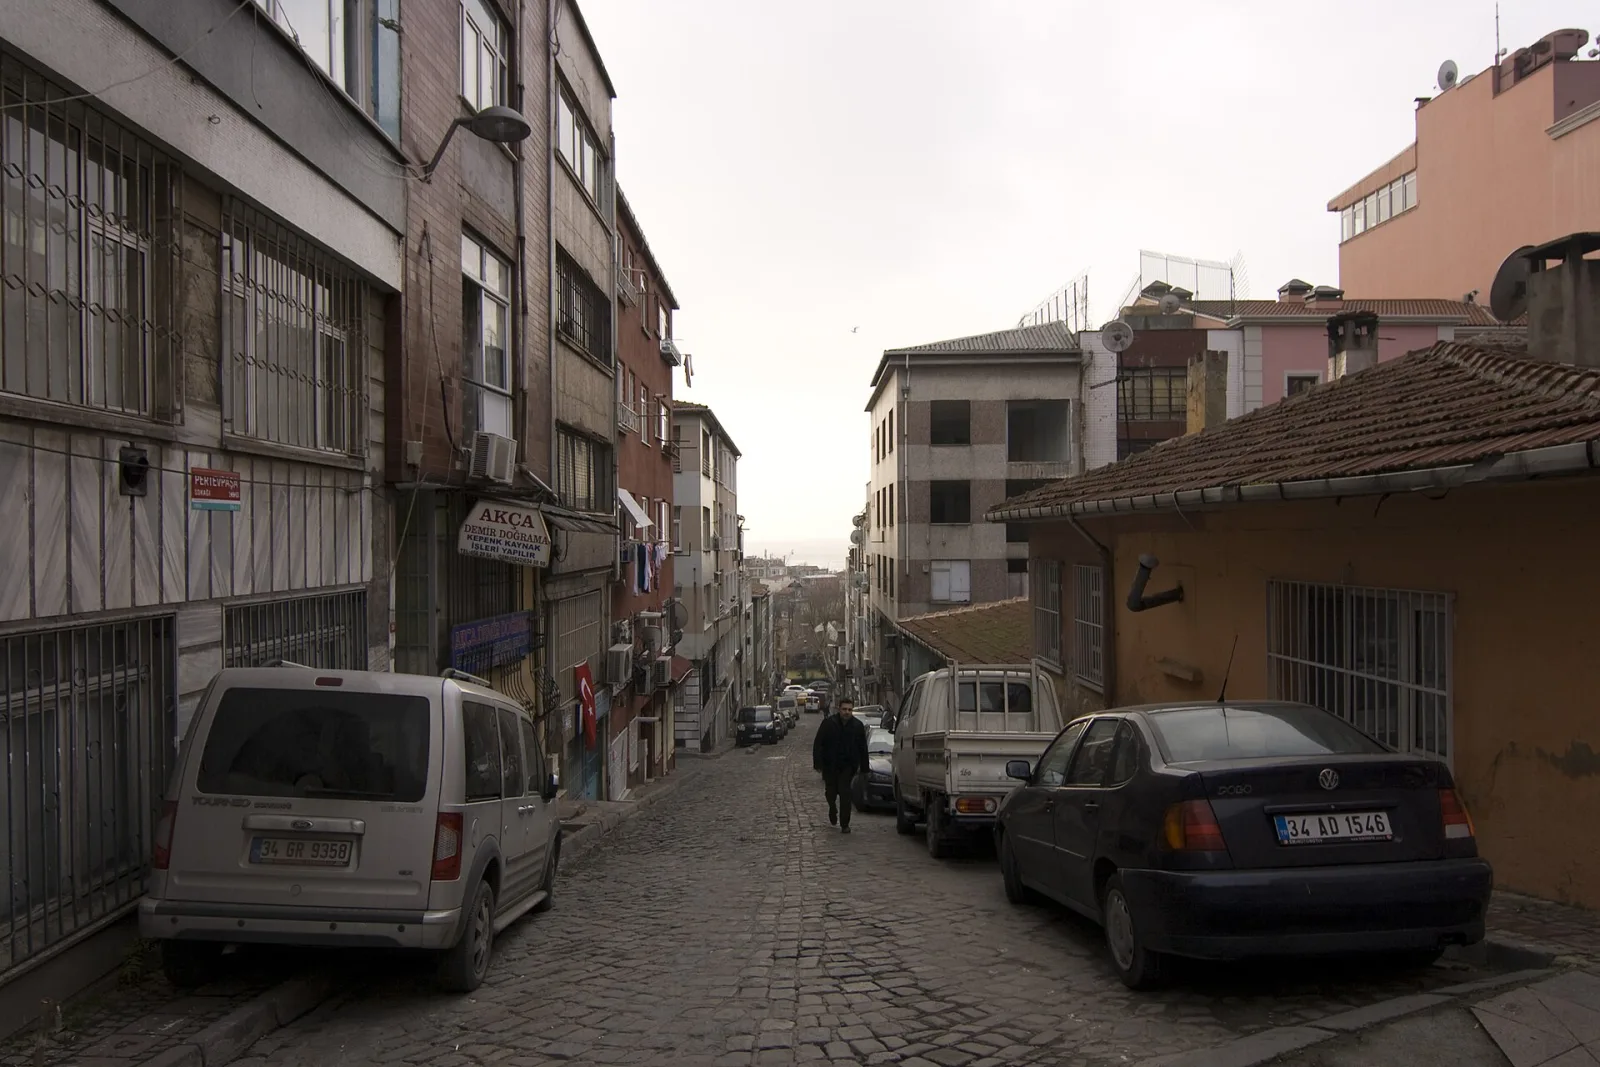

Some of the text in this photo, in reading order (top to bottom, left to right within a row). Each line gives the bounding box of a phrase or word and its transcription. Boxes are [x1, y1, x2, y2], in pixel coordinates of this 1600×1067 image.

[479, 508, 535, 529] AKÇA
[464, 524, 549, 545] DEMİR DOĞRAMA
[467, 534, 541, 551] KEPENK KAYNAK
[471, 542, 499, 553] İŞLERİ
[502, 547, 536, 559] YAPILIR
[192, 796, 251, 807] TOURNEO
[1287, 814, 1385, 837] 34 AD 1546
[261, 840, 347, 859] 34 GR 9358
